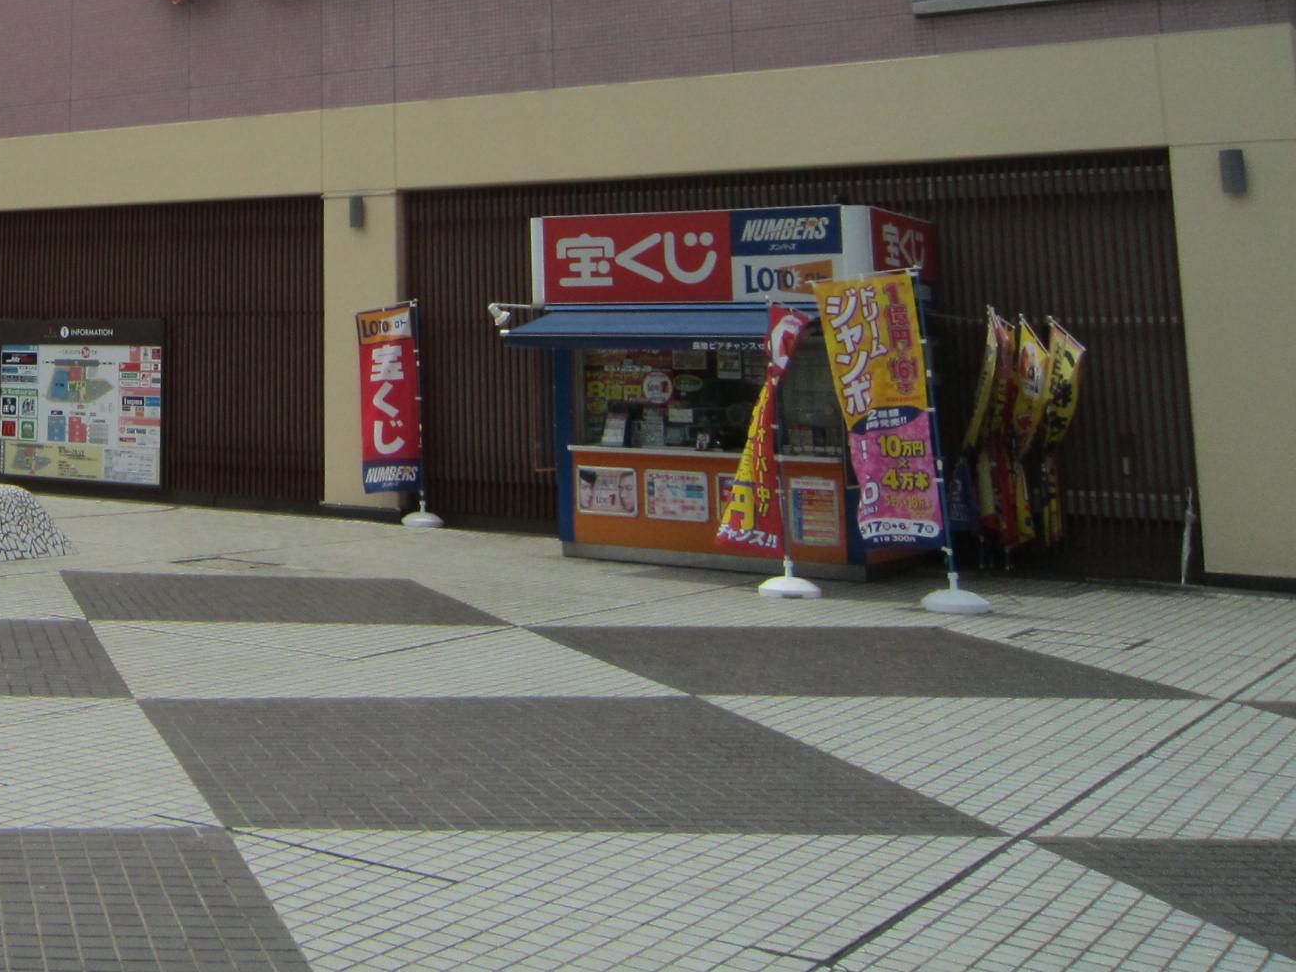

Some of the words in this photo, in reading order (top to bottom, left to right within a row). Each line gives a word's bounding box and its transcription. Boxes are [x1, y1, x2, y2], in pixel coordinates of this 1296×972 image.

[741, 216, 830, 242] NUMBERS
[556, 231, 718, 287] 宝くじ
[882, 222, 926, 268] 宝くじ
[744, 264, 795, 294] LOTO
[70, 327, 113, 337] INFORMATION
[860, 285, 888, 359] ドリーム
[825, 287, 873, 416] ジャンボ
[370, 344, 405, 455] 宝くじ
[878, 435, 925, 458] 10万円
[365, 465, 418, 484] NUMBERS
[882, 468, 930, 490] 4万本
[717, 524, 779, 548] チャンス!!
